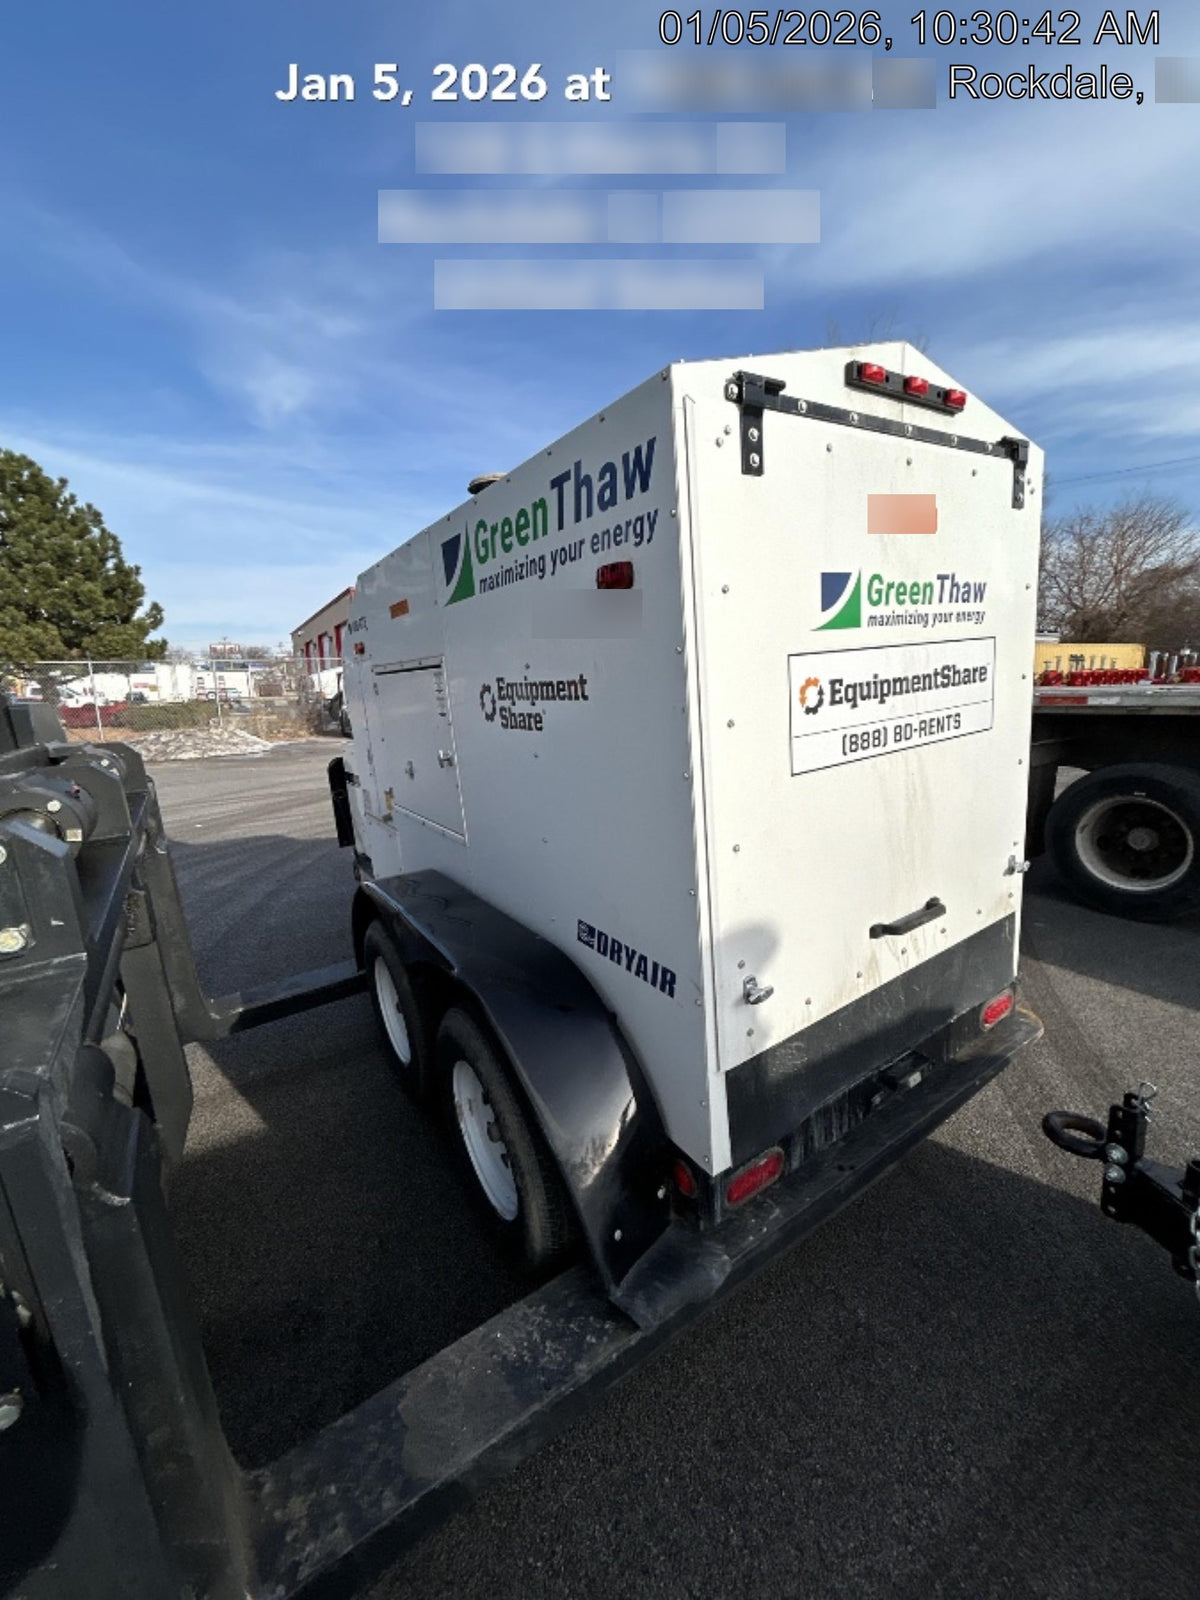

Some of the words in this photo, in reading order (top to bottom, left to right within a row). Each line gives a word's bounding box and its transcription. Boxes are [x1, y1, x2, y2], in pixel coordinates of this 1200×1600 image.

[479, 553, 546, 594] maximizing
[550, 538, 585, 576] your
[590, 509, 659, 554] energy
[867, 609, 929, 628] maximizing
[931, 611, 954, 628] your
[955, 610, 986, 625] energy
[496, 674, 589, 706] Equipment
[829, 665, 988, 709] EquipmentShare
[500, 706, 543, 731] Share
[842, 726, 888, 756] (888)
[597, 929, 677, 997] DRYAIR
